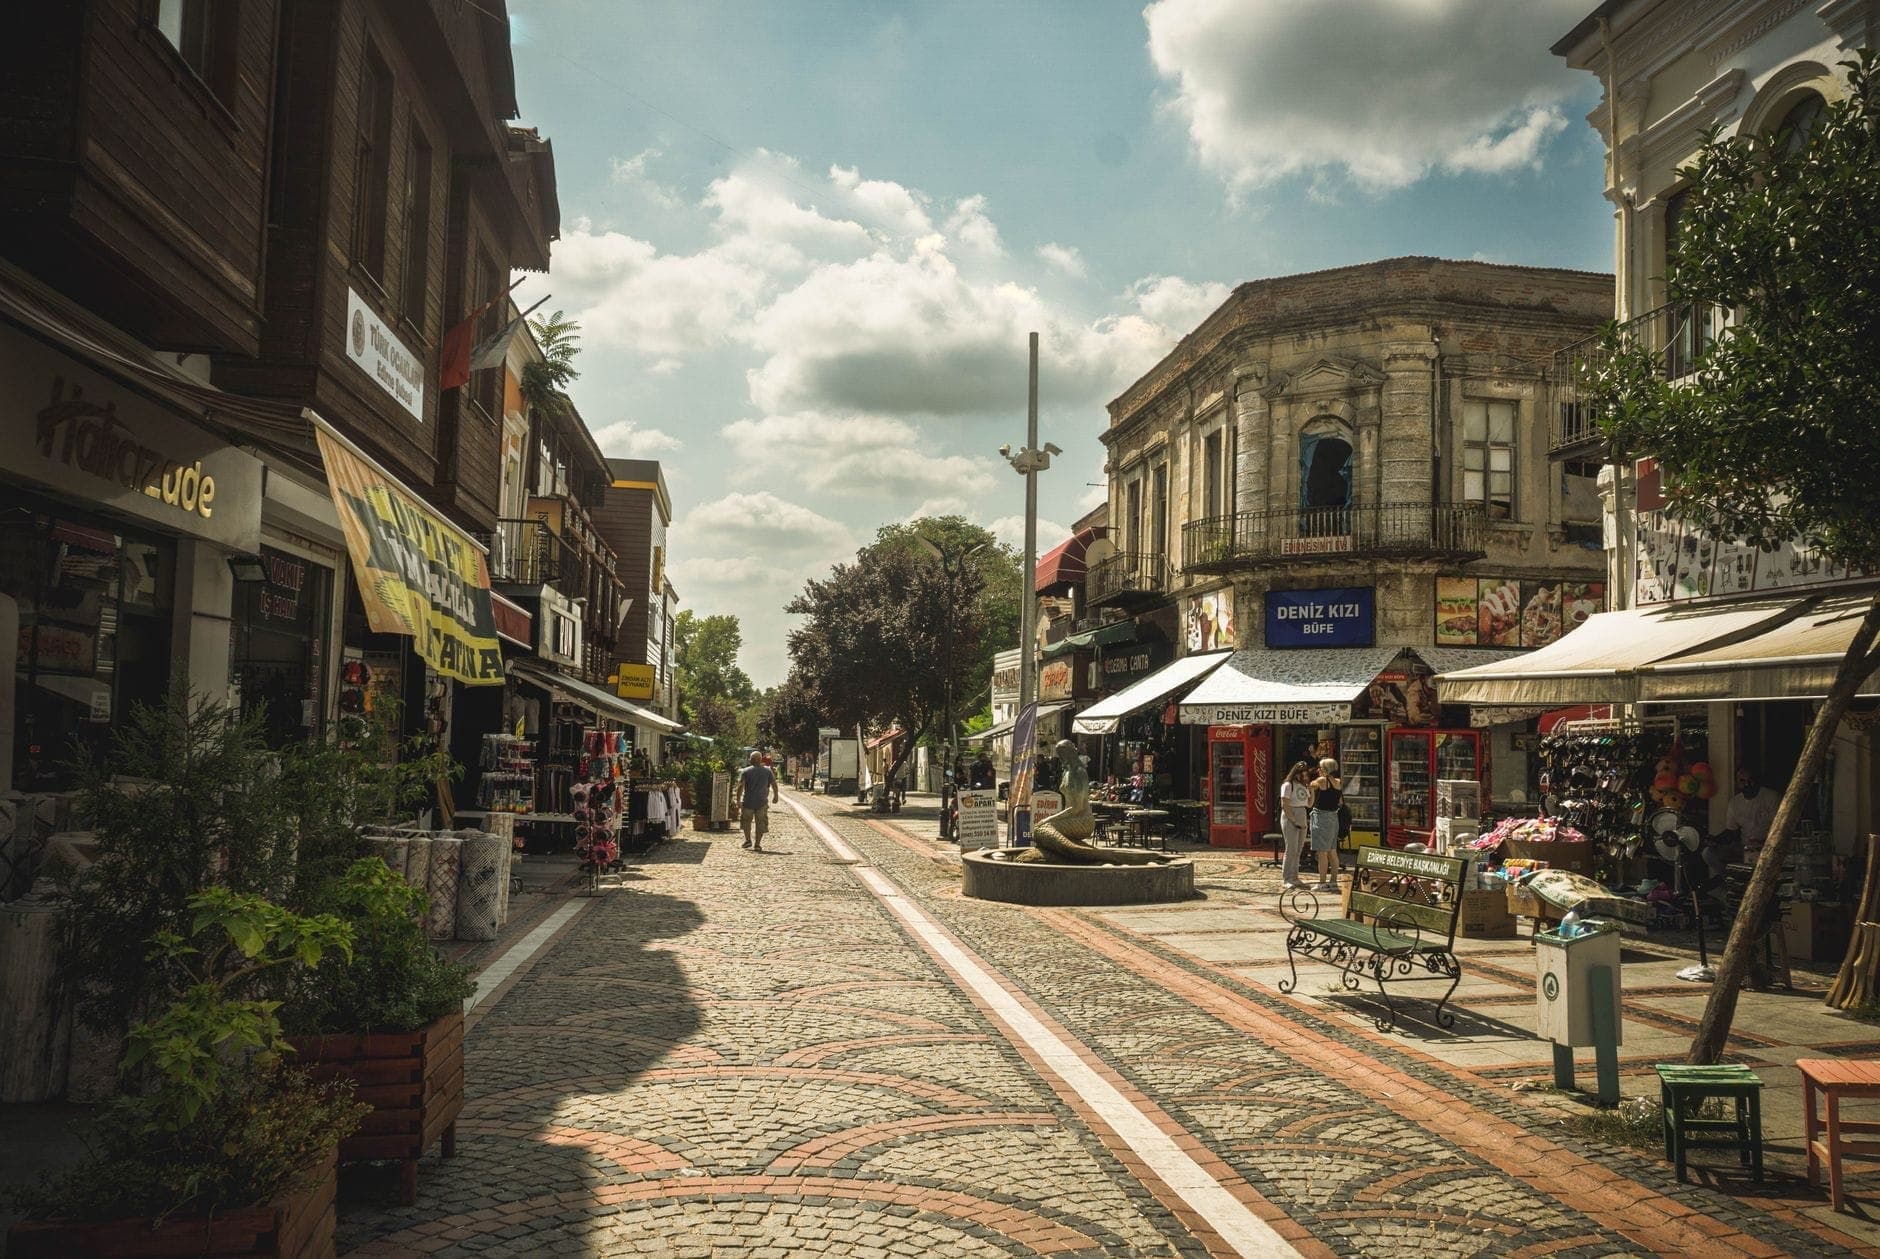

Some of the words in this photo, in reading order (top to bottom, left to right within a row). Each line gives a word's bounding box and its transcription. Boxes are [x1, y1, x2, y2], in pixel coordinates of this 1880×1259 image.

[370, 324, 389, 361] TÜRK
[1277, 602, 1324, 619] DENİZ
[1329, 604, 1359, 618] KIZI
[1303, 622, 1334, 634] BÜFE
[1217, 708, 1251, 720] DENİZ
[1253, 709, 1276, 720] KIZI
[1280, 707, 1308, 720] BÜFE
[1367, 851, 1386, 863] EDİRNE
[1386, 854, 1413, 869] BELEDİYE
[1413, 858, 1449, 876] BAŞKANLIĞI
